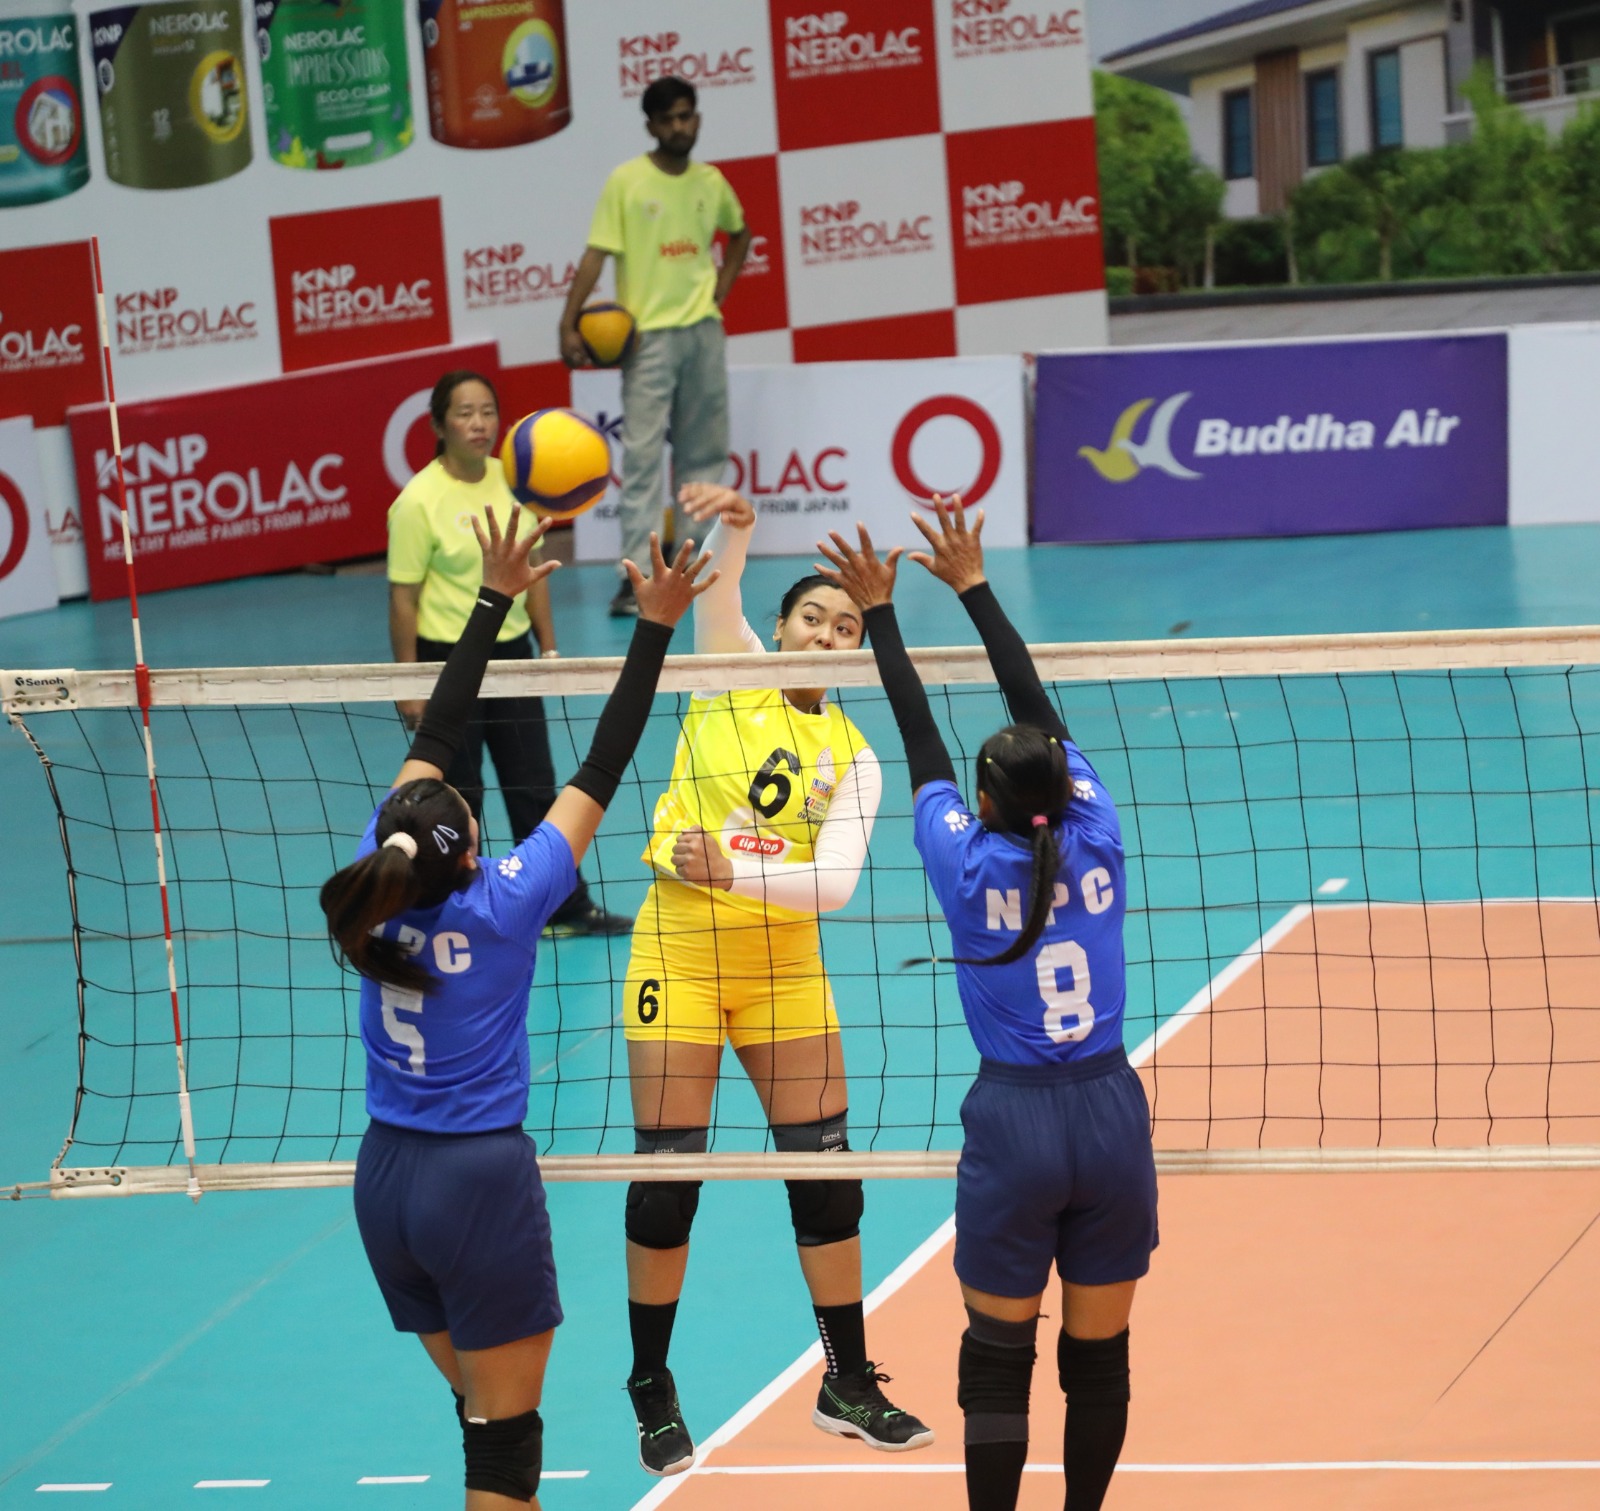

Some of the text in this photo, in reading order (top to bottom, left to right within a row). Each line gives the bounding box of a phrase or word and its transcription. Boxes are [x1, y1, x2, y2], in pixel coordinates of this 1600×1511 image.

[94, 24, 122, 45] KNP
[150, 11, 229, 35] NEROLAC
[284, 26, 367, 53] NEROLAC
[785, 11, 848, 39] KNP
[952, 9, 1081, 48] NEROLAC
[619, 32, 680, 58] KNP
[785, 27, 922, 68] NEROLAC
[619, 47, 754, 87] NEROLAC
[801, 200, 860, 226] KNP
[962, 180, 1025, 208] KNP
[801, 215, 932, 254] NEROLAC
[963, 195, 1097, 237] NEROLAC
[463, 243, 525, 269] KNP
[292, 264, 356, 293] KNP
[464, 261, 577, 299] NEROLA
[115, 287, 178, 315] KNP
[292, 279, 431, 325] NEROLAC
[116, 302, 257, 345] NEROLAC
[1194, 408, 1460, 457] Buddha Air
[94, 434, 207, 489] KNP
[98, 454, 348, 542] NEROLAC
[169, 528, 210, 548] HOME
[210, 517, 262, 540] PAINTS
[263, 509, 302, 531] FROM
[304, 501, 351, 525] JAPAN
[26, 677, 64, 686] Senoh
[748, 747, 801, 819] 6
[738, 837, 779, 854] tip top
[985, 866, 1115, 931] NPC
[368, 922, 472, 974] PC
[637, 979, 661, 1024] 6
[1035, 940, 1095, 1044] 8
[380, 982, 426, 1077] 5
